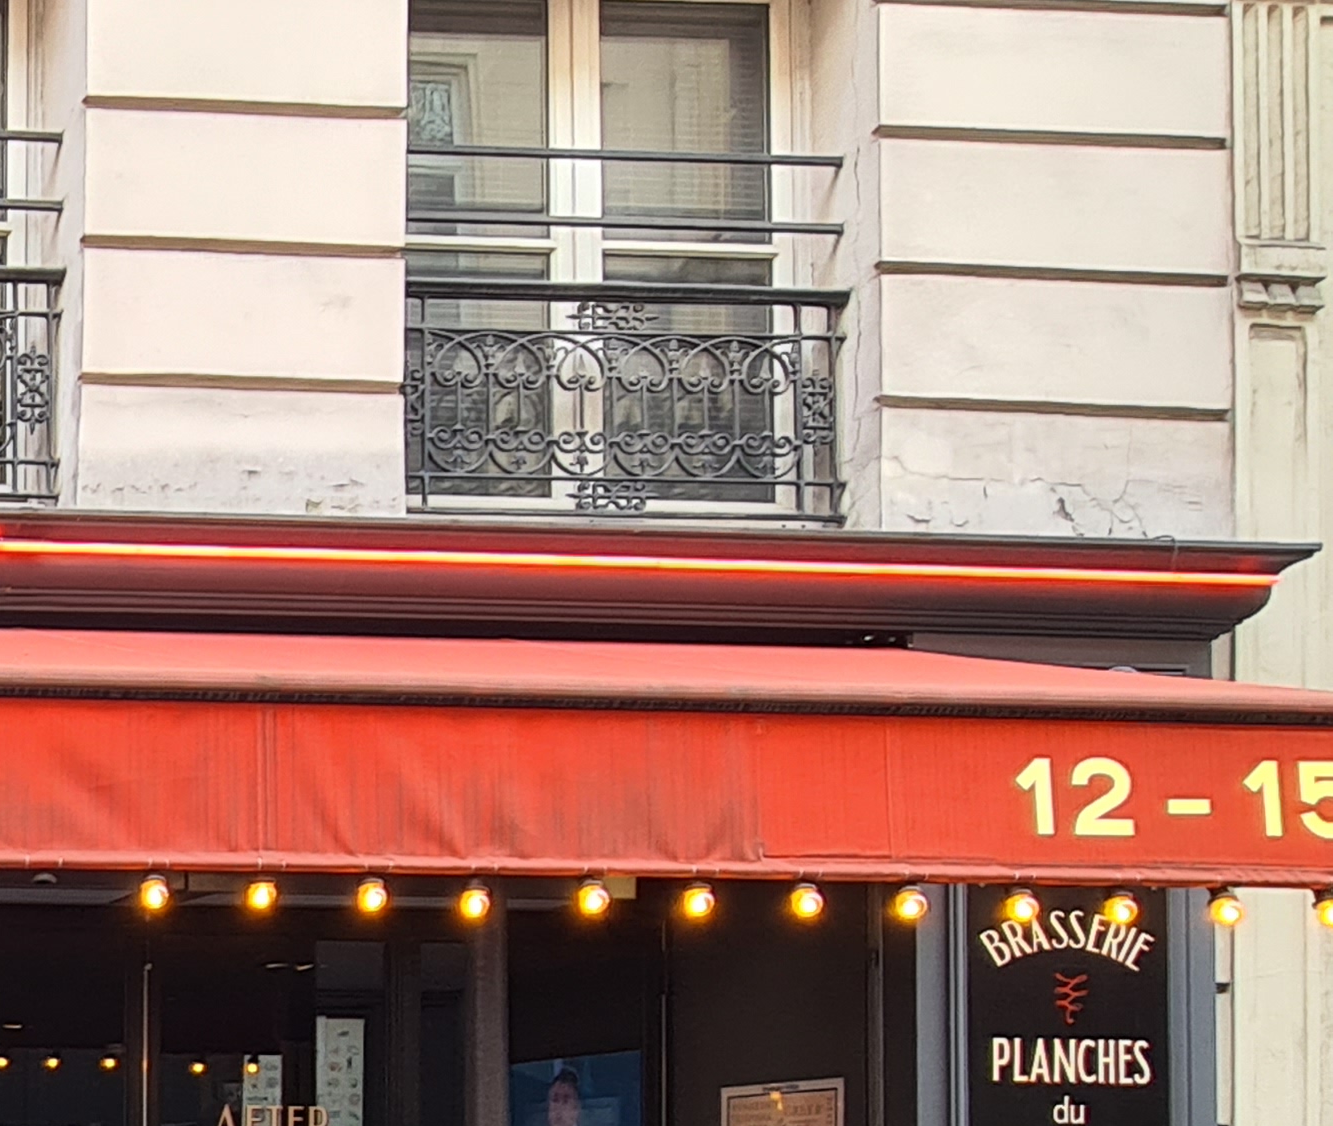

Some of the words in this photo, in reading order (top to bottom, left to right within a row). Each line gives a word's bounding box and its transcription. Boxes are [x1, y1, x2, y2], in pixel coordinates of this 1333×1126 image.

[979, 909, 1156, 972] BRASSERIE
[991, 1037, 1153, 1086] PLANCHES
[1052, 1095, 1086, 1126] du
